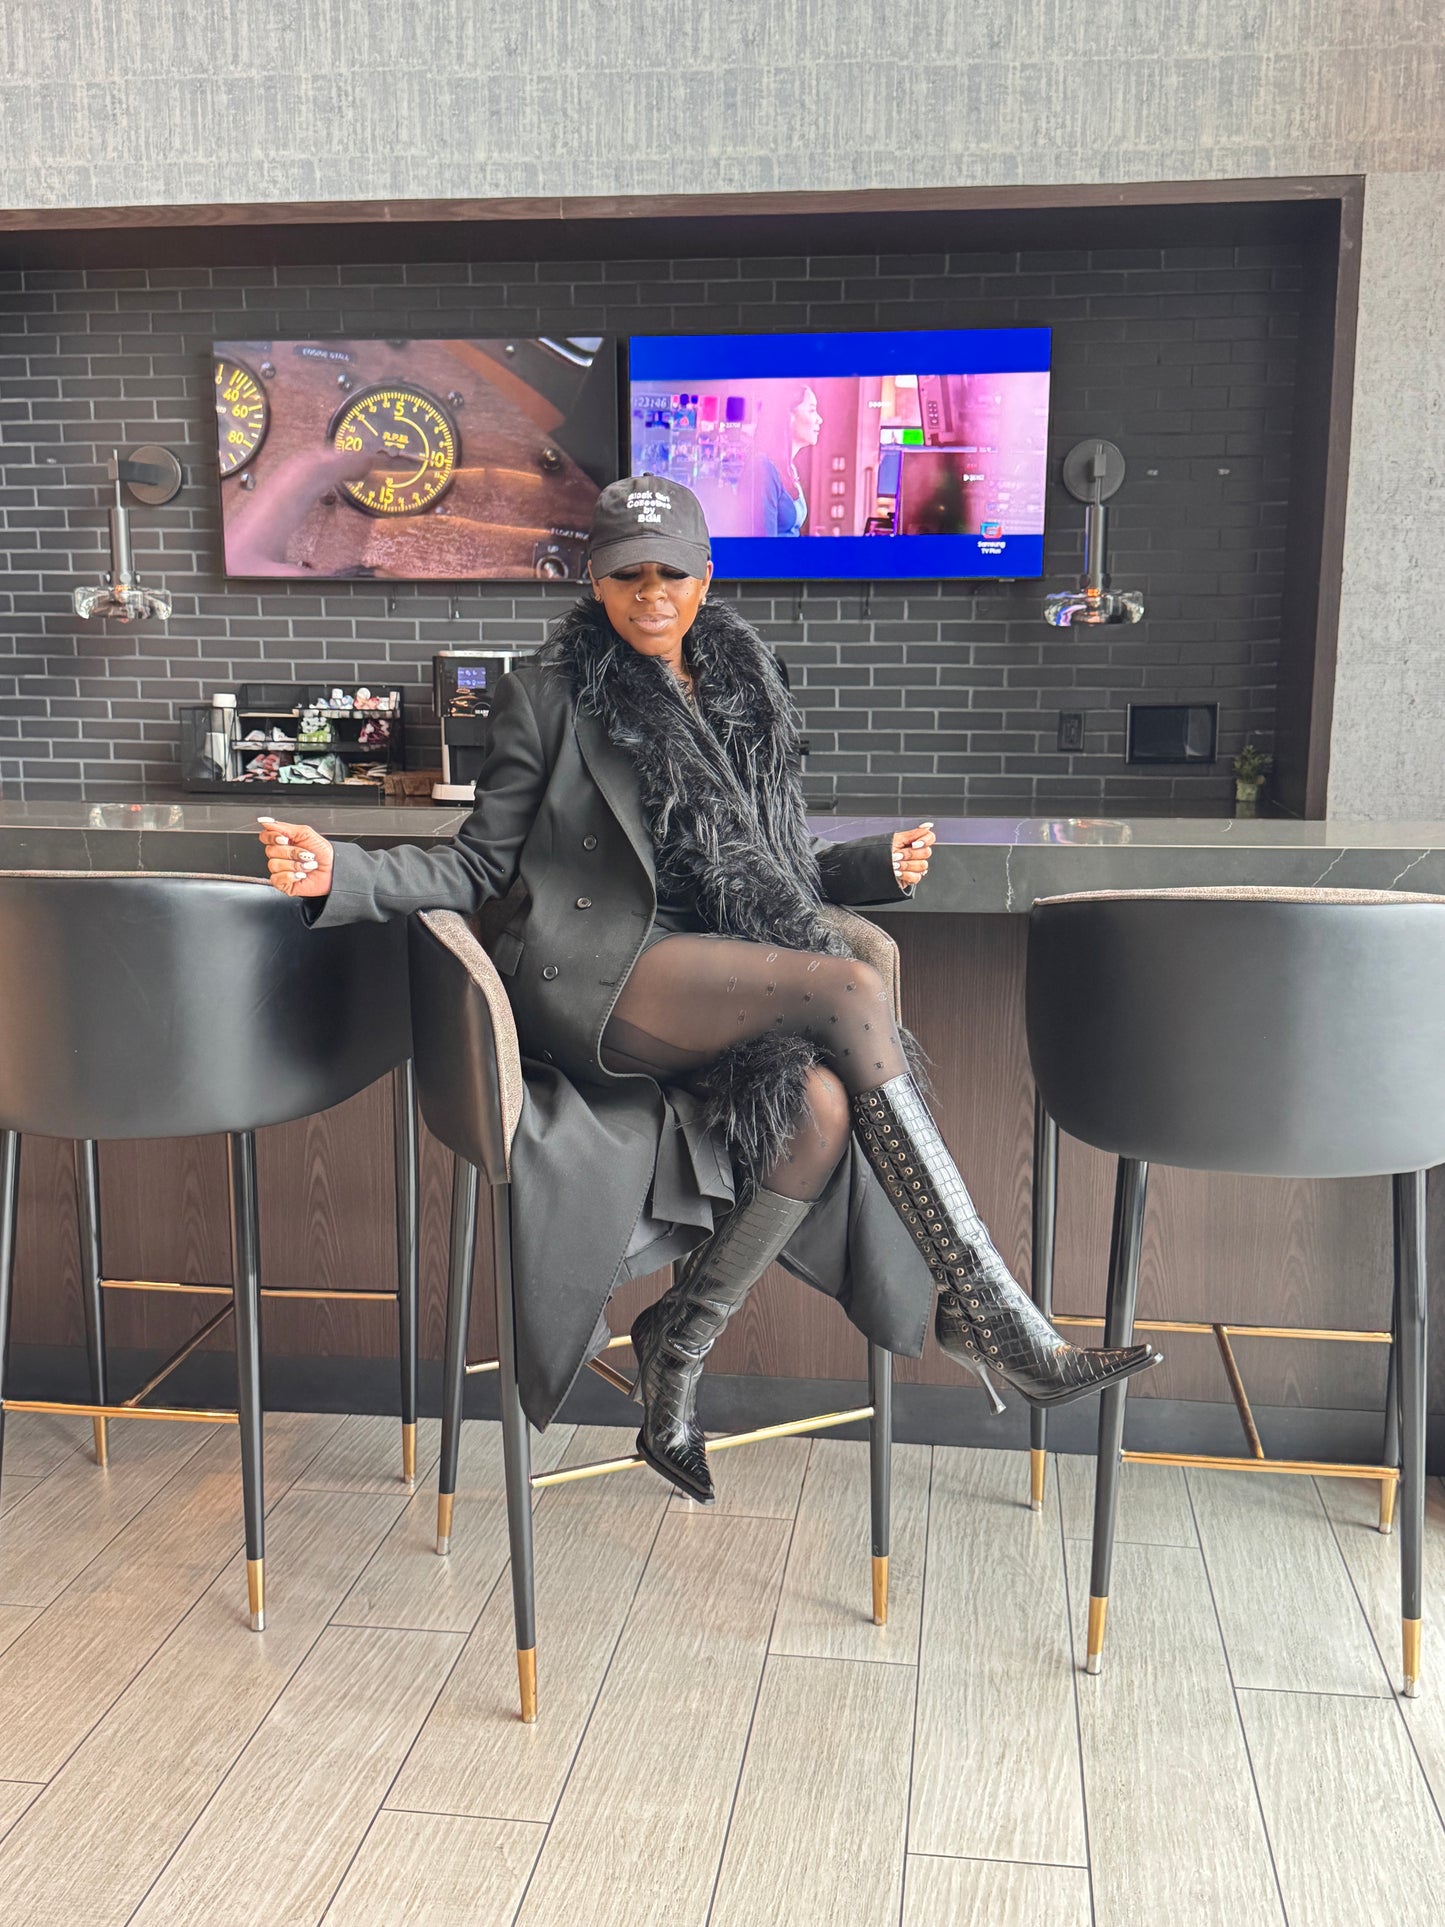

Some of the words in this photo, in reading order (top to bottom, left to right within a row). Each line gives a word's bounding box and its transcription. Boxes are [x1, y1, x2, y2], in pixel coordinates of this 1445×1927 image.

[223, 388, 240, 401] 40
[231, 404, 249, 418] 60
[394, 401, 405, 417] 5
[228, 430, 244, 444] 80
[344, 436, 363, 452] 20
[379, 486, 395, 504] 15
[643, 506, 656, 515] by
[637, 513, 662, 523] BGM
[977, 541, 1006, 549] Samsung
